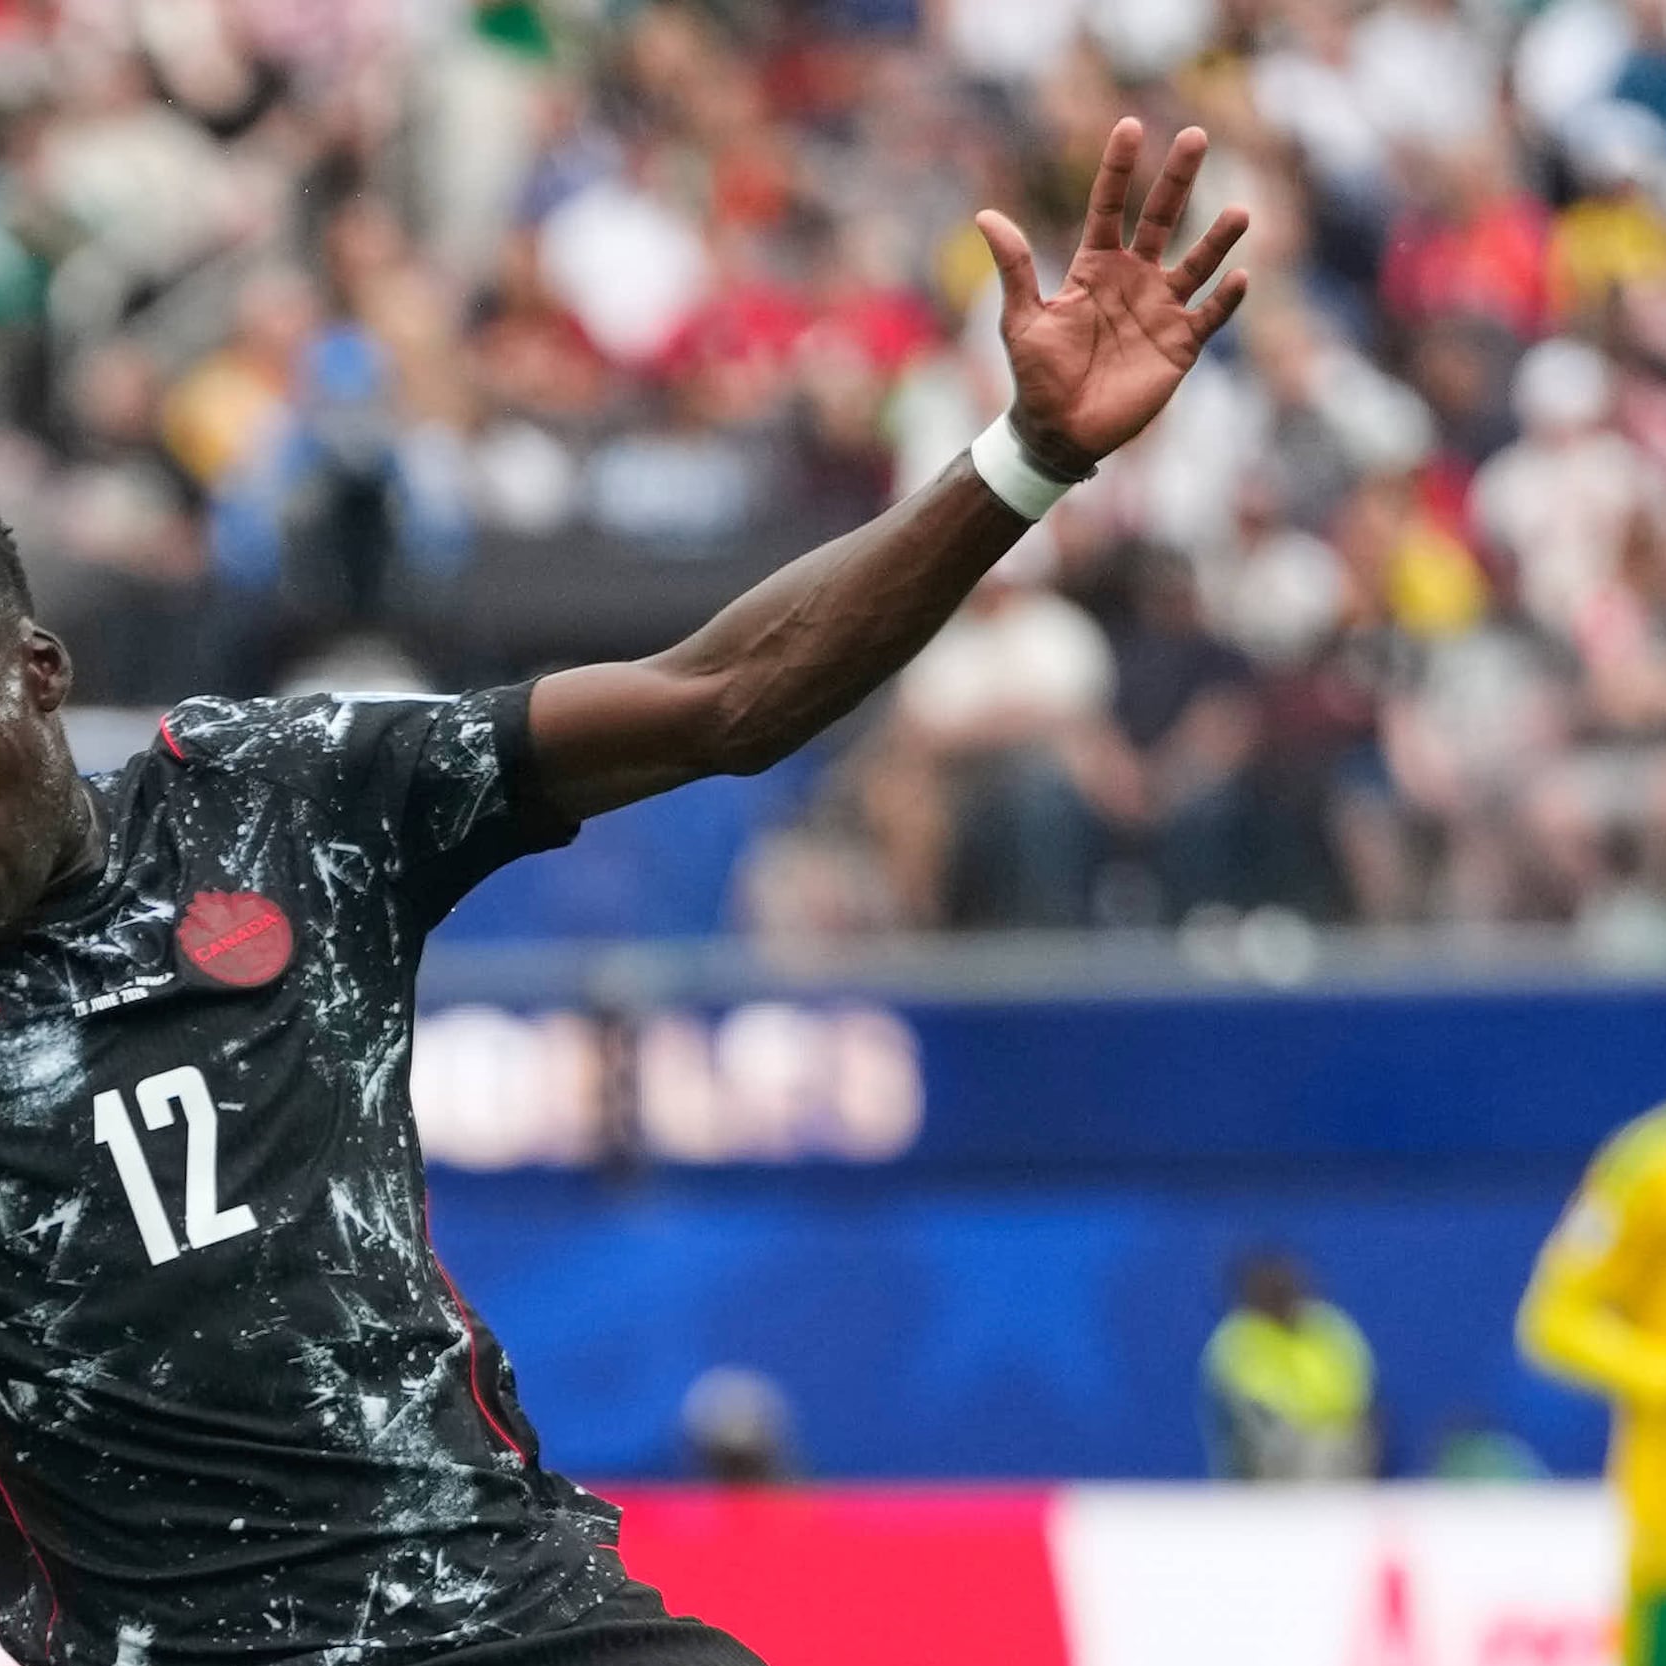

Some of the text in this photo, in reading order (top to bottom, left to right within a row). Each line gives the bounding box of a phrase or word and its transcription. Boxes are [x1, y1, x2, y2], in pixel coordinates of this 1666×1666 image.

[194, 913, 281, 962] CANADA
[89, 992, 120, 1013] JUNE
[119, 986, 150, 1004] 2026
[93, 1065, 259, 1267] 12
